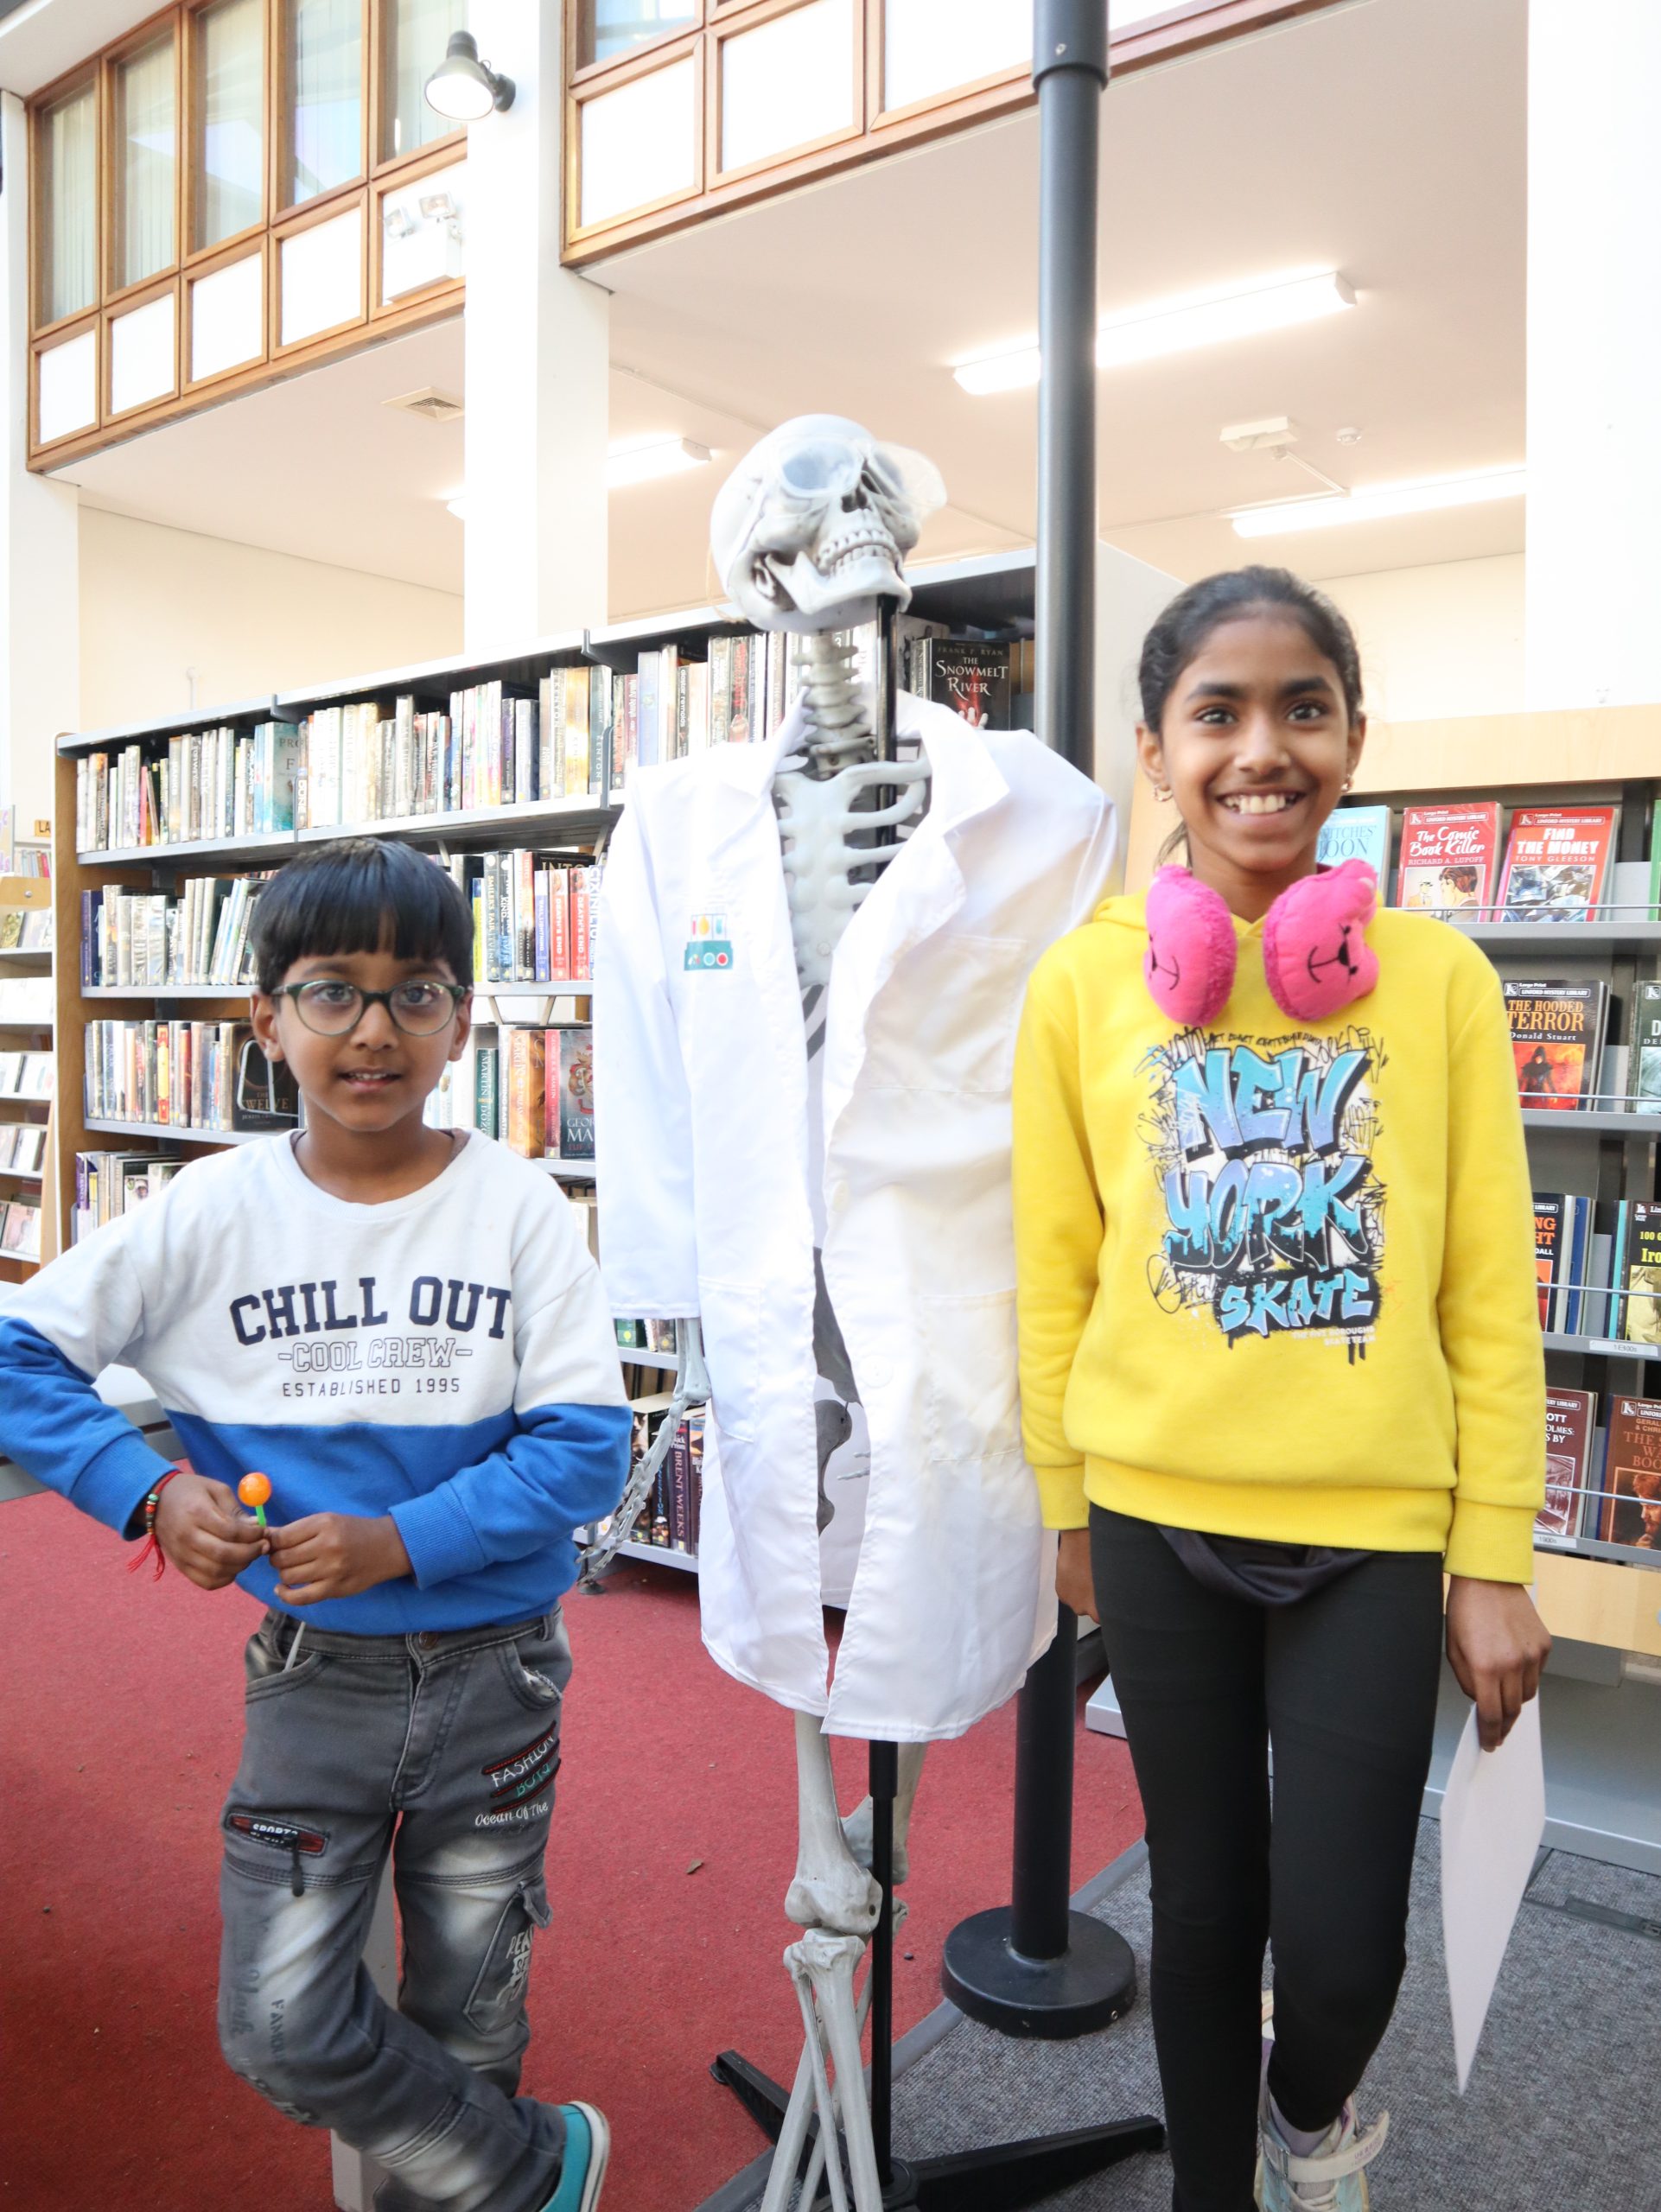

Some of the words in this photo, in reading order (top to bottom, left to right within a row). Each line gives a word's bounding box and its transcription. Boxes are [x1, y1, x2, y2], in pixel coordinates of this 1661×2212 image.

[935, 660, 1009, 679] SNOWMELT
[947, 677, 992, 701] RIVER
[298, 779, 308, 814] DUNE
[1416, 830, 1436, 843] The
[1437, 826, 1480, 842] Comic
[1543, 828, 1575, 841] FIND
[1410, 841, 1443, 857] Book
[1445, 838, 1486, 856] Killer
[1517, 841, 1543, 855] THE
[1547, 841, 1600, 855] MONEY
[1508, 1000, 1532, 1012] THE
[1535, 1000, 1585, 1013] HOODED
[1507, 1011, 1585, 1032] TERROR
[1510, 1032, 1543, 1040] Donald
[1173, 1046, 1367, 1154] NEW
[1164, 1154, 1369, 1272] YORK
[1639, 1230, 1654, 1241] 100
[229, 1277, 388, 1345] CHILL
[409, 1276, 512, 1339] OUT
[1220, 1268, 1375, 1336] SKATE
[1329, 1325, 1375, 1336] BOROUGHS
[283, 1378, 401, 1397] ESTABLISHED
[416, 1377, 461, 1394] 1995
[1553, 1434, 1566, 1444] BY
[1624, 1431, 1655, 1446] THE
[674, 1451, 684, 1489] BRENT
[677, 1493, 685, 1537] WEEKS
[491, 1735, 555, 1787] FASHION
[474, 1812, 513, 1827] Ocean
[529, 1802, 549, 1816] The
